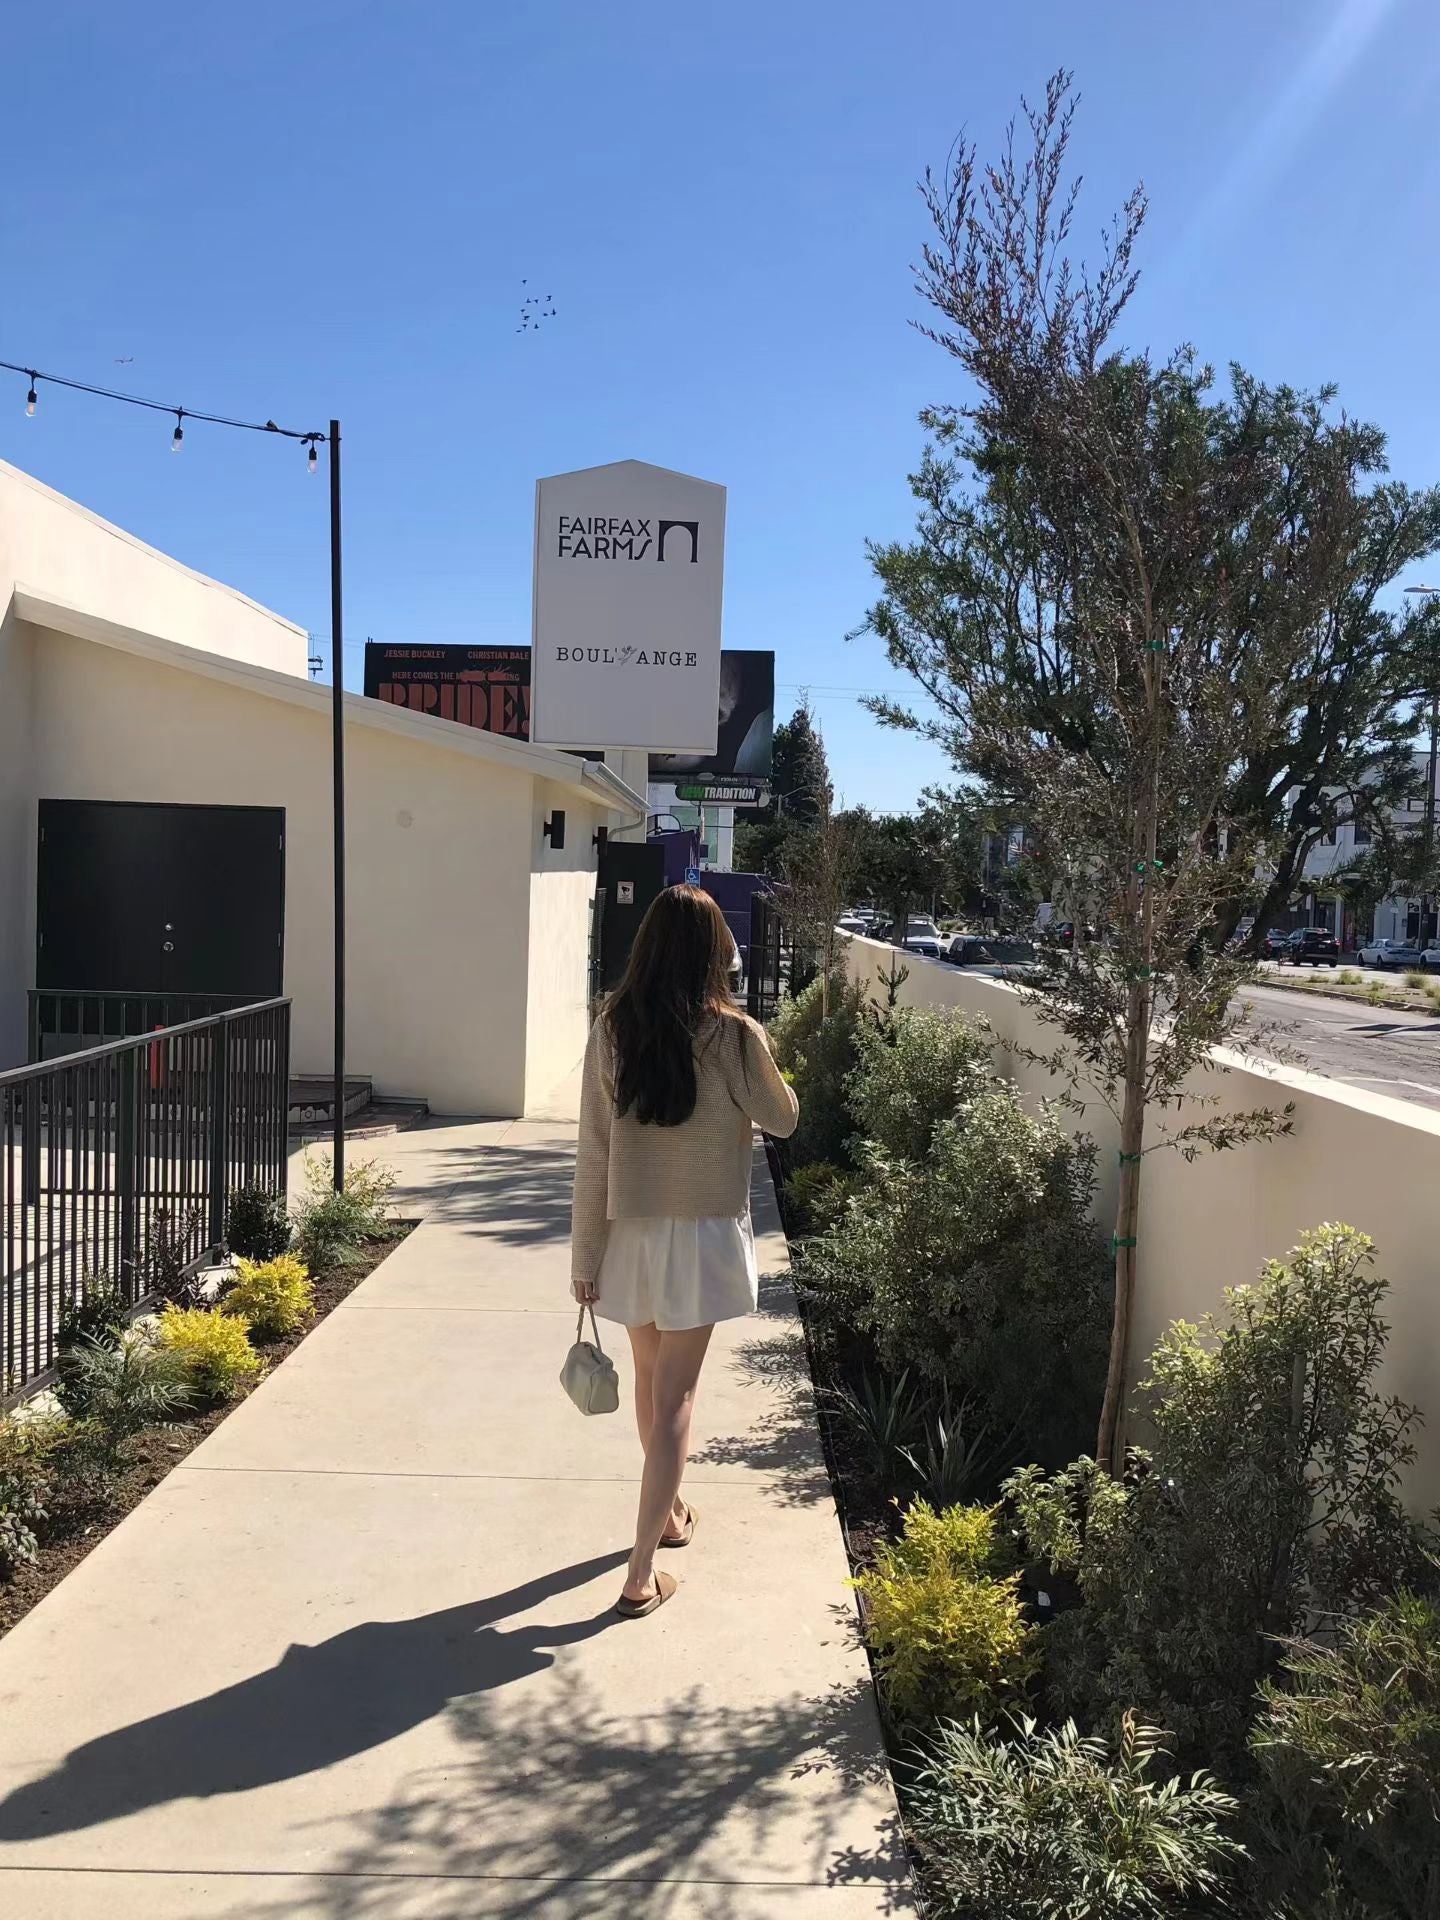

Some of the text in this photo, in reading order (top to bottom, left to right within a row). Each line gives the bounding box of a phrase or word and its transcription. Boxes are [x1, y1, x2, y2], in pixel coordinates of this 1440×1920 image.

[558, 516, 651, 537] FAIRFAX
[558, 535, 653, 561] FARMS
[384, 650, 446, 659] JESSIE BUCKLEY
[467, 651, 529, 660] CHRISTIAN BALE
[392, 671, 411, 679] HERE
[413, 671, 438, 680] COMES
[440, 672, 455, 680] THE
